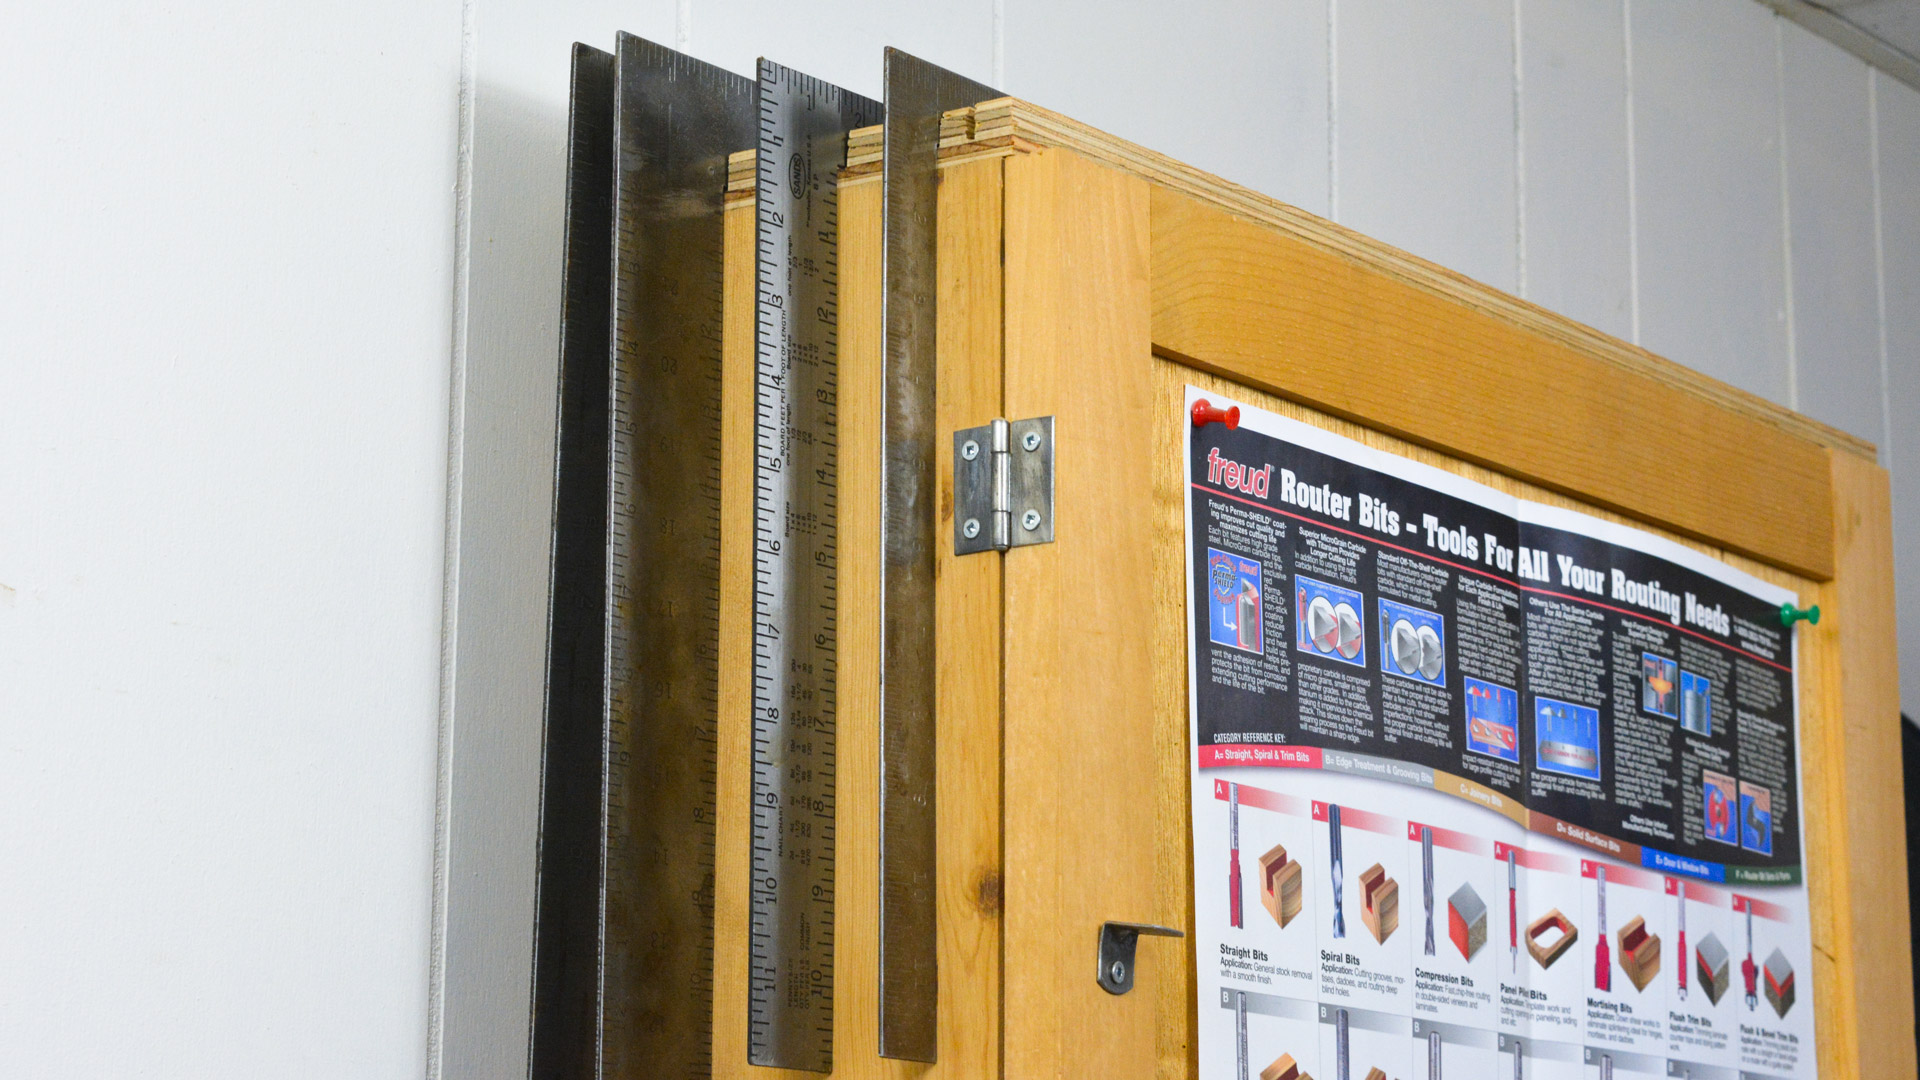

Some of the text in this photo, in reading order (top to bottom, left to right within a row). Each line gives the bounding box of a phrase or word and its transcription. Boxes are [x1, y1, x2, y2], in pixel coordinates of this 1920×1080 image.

[793, 157, 802, 195] SANDS
[772, 211, 783, 224] 2
[771, 294, 783, 306] 3
[781, 344, 786, 355] OF
[771, 374, 781, 386] 4
[770, 457, 781, 468] 5
[1220, 512, 1244, 525] improves
[1256, 524, 1273, 535] quality
[1275, 529, 1284, 538] and
[768, 540, 780, 551] 6
[1207, 447, 1270, 499] freud
[1281, 468, 1352, 522] Router
[1358, 493, 1400, 537] Bits
[1423, 513, 1478, 561] Tools
[1484, 532, 1513, 573] For
[1517, 545, 1550, 583] All
[1556, 553, 1605, 596] Your
[1611, 567, 1680, 626] Routing
[1685, 591, 1730, 637] Needs
[815, 551, 826, 562] 5
[768, 623, 779, 633] 7
[767, 707, 778, 719] 8
[1213, 732, 1241, 743] CATEGORY
[1242, 732, 1273, 743] REFERENCE
[1254, 748, 1273, 761] Spiral
[1280, 750, 1294, 761] Trim
[1296, 750, 1309, 762] Bits
[1335, 755, 1352, 768] Edge
[1353, 758, 1386, 774] Treatment
[1392, 765, 1419, 782] Grooving
[1421, 771, 1432, 783] Bits
[1215, 785, 1223, 794] A
[766, 792, 777, 806] 9
[812, 800, 824, 811] 8
[1313, 806, 1320, 815] A
[1408, 825, 1415, 835] A
[765, 877, 776, 904] 10
[1219, 942, 1268, 961] Straight Bits
[1320, 949, 1359, 966] Spiral Bits
[1253, 961, 1274, 974] General
[1414, 967, 1473, 987] Compression Bits
[1222, 992, 1229, 1002] B
[1530, 989, 1547, 1001] Bits
[1320, 1006, 1327, 1017] B
[1587, 998, 1632, 1014] Mortising Bits
